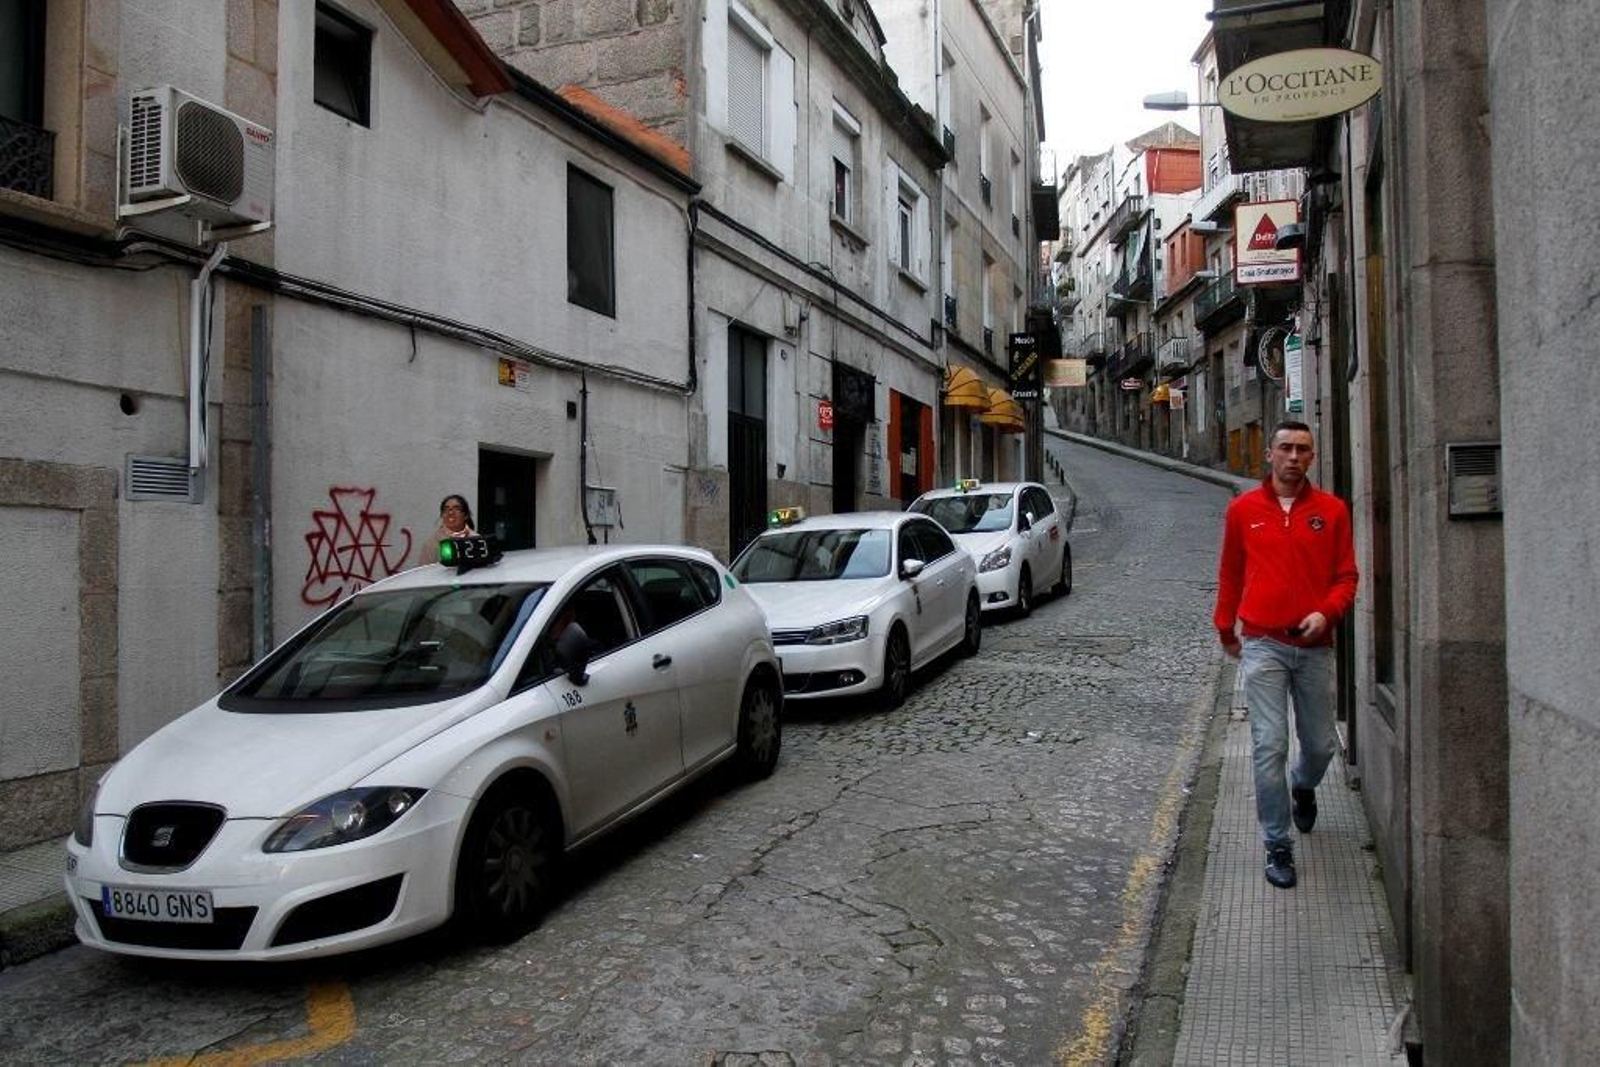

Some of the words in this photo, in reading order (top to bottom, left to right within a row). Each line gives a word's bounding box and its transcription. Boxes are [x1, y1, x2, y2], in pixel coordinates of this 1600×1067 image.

[1229, 64, 1374, 97] L'OCCITANE
[561, 689, 582, 708] 188
[113, 890, 159, 917] 8840
[166, 893, 208, 918] GNS
